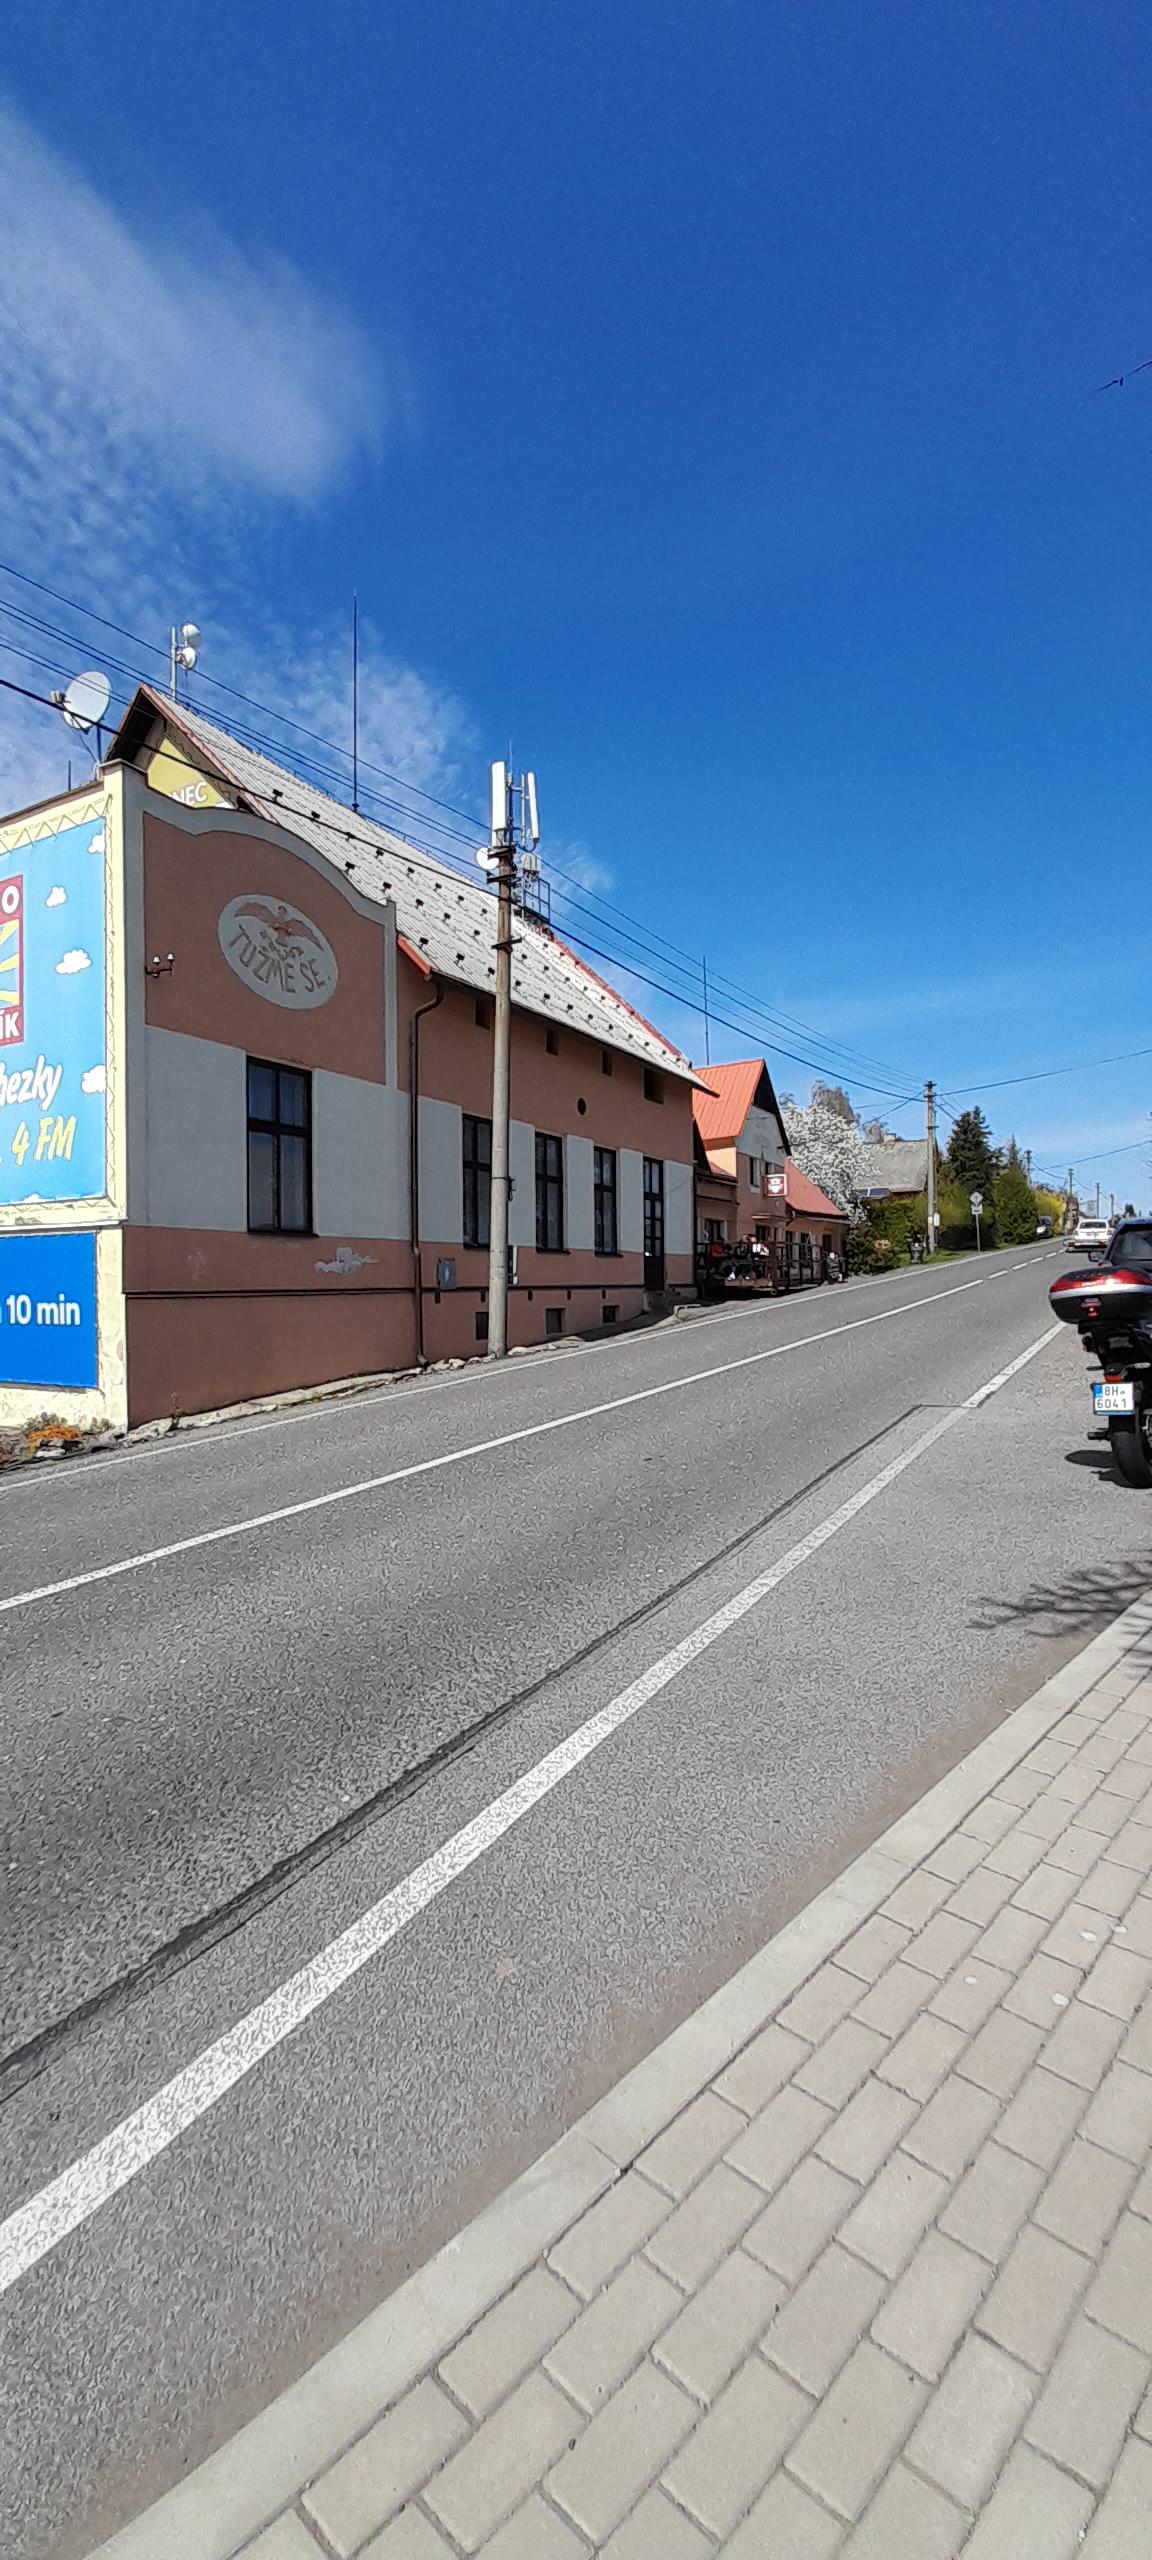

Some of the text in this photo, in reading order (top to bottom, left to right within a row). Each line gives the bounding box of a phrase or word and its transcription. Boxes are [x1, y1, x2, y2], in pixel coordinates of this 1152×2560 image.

[167, 781, 208, 804] NEC
[33, 1114, 77, 1160] FM
[6, 1294, 31, 1325] 10
[36, 1293, 80, 1325] min
[1097, 1399, 1127, 1409] 6041
